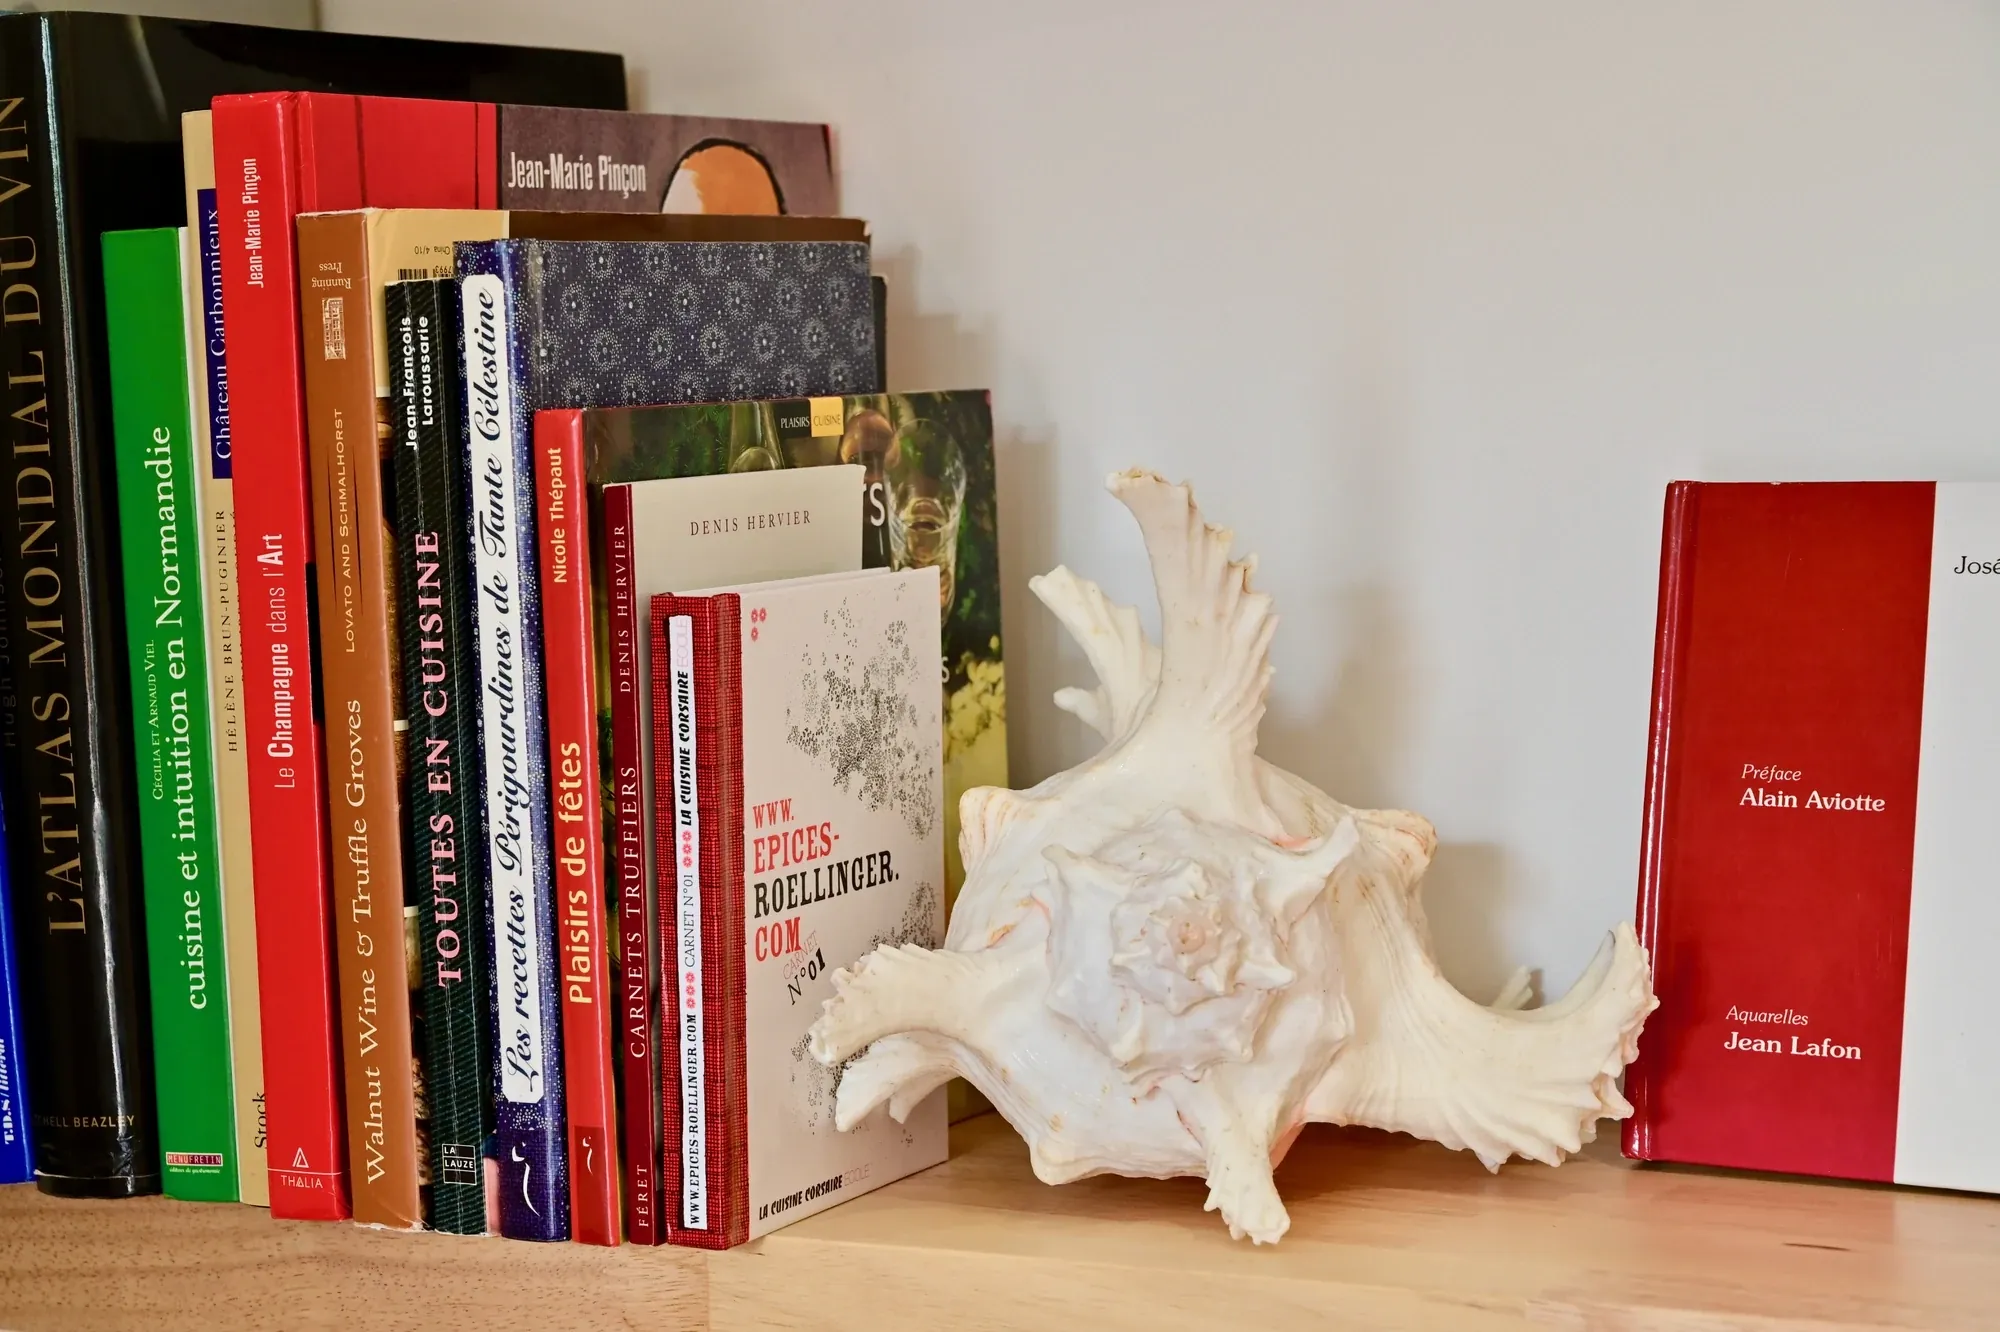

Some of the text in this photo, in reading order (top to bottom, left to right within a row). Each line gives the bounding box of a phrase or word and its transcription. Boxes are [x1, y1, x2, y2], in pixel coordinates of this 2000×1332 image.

[508, 151, 646, 199] Jean-Marie Pinçon
[242, 158, 264, 289] Jean-Marie Pinçon
[414, 245, 450, 255] China 4/10
[311, 277, 352, 290] Running
[319, 262, 342, 274] Press
[205, 209, 232, 459] Château Carbonnieux
[399, 316, 417, 451] Jean-François
[417, 315, 434, 426] Laroussarie
[780, 413, 841, 429] PLAISIRS CUISINE
[0, 97, 87, 935] L'ATLAS MONDIAL DU VIN
[334, 408, 355, 653] LOVATO AND SCHMALHORST
[547, 446, 567, 584] Nicole Thépaut
[690, 509, 812, 536] DENIS HERVIER
[215, 510, 238, 752] HÉLÈNE BRUN-PUGINIER
[614, 525, 630, 693] DENIS HERVIER
[257, 533, 295, 789] Le Champagne dans l'Art
[473, 286, 540, 1093] Les recettes Périgourdines de Tante Célestine
[144, 426, 207, 1010] cuisine et intuition en Normandie
[677, 670, 690, 743] CORSAIRE
[415, 531, 462, 989] TOUTES EN CUISINE
[679, 746, 692, 805] CUISINE
[1741, 763, 1802, 783] Préface
[681, 809, 692, 826] LA
[752, 798, 794, 829] WWW.
[1739, 787, 1886, 812] Alain Aviotte
[558, 741, 592, 1004] Plaisirs de fêtes
[753, 821, 840, 874] EPICES-
[620, 766, 646, 1059] CARNETS TRUFFIERS
[753, 850, 899, 918] ROELLINGER.
[346, 699, 386, 1185] Walnut Wine & Truffle Groves
[683, 874, 695, 968] CARNET N°01
[755, 916, 801, 962] COM
[782, 930, 819, 980] CARNET
[1725, 1005, 1809, 1026] Aquarelles
[1723, 1031, 1861, 1060] Jean Lafon
[73, 1115, 135, 1128] BEAZLEY
[252, 1091, 268, 1149] Stock
[686, 1014, 700, 1225] WWW.EPICES-ROELLINGER.COM
[168, 1155, 221, 1165] MENUFRETIN
[444, 1145, 456, 1155] LA
[444, 1159, 474, 1169] LAUZE
[280, 1174, 323, 1189] THALIA
[636, 1165, 649, 1227] FÉRET
[759, 1204, 768, 1221] LA
[770, 1190, 803, 1215] CUISINE
[804, 1174, 843, 1202] CORSAIRE
